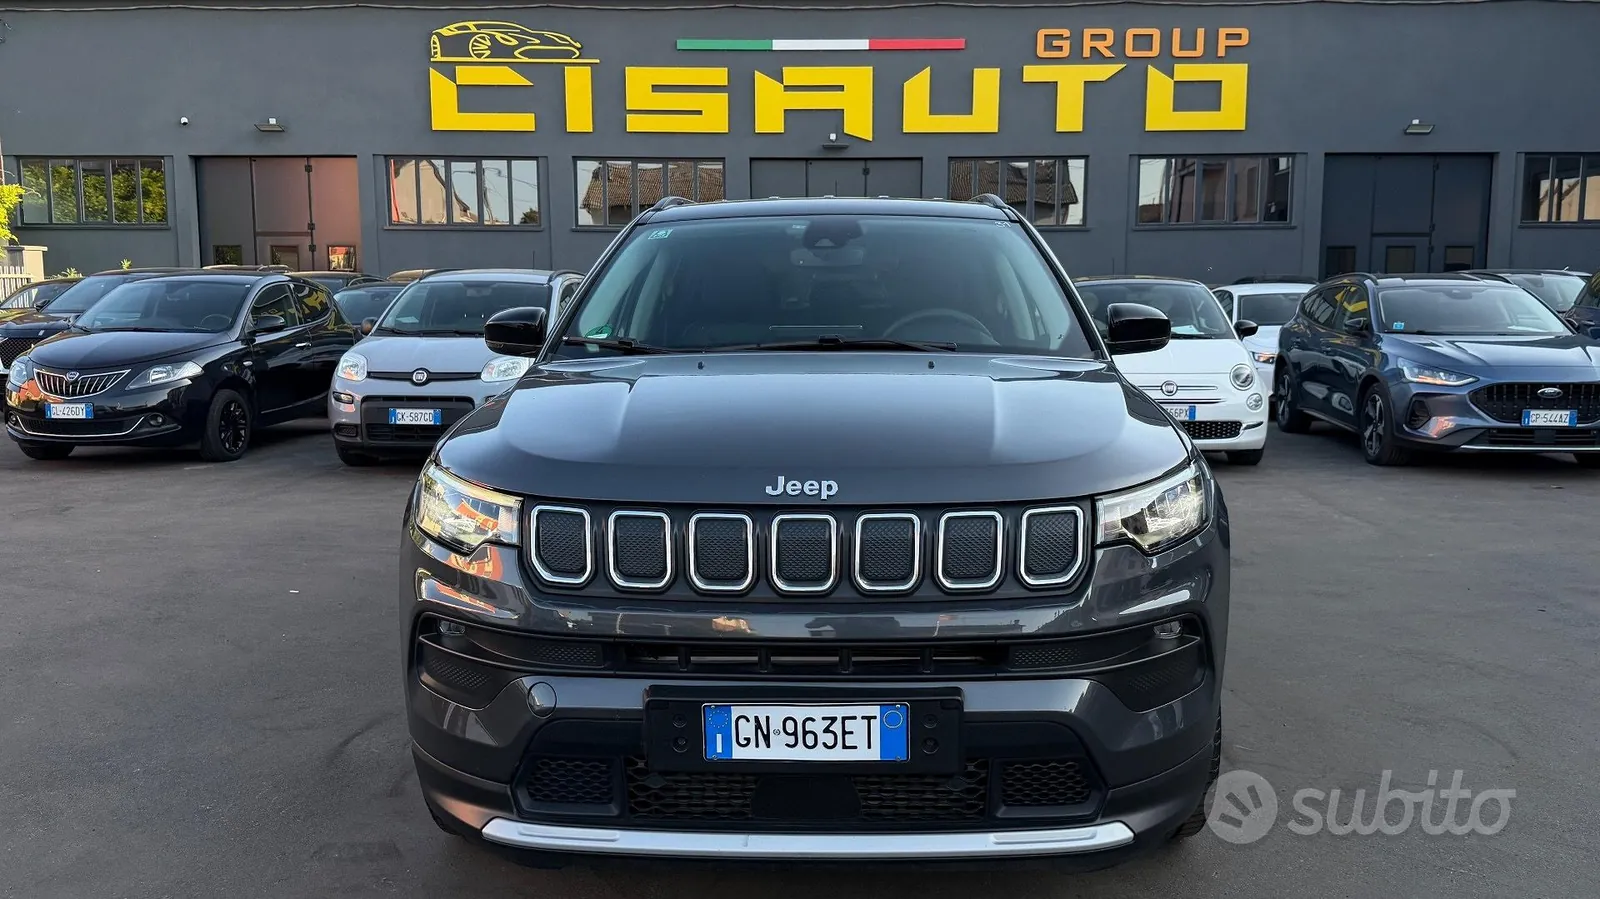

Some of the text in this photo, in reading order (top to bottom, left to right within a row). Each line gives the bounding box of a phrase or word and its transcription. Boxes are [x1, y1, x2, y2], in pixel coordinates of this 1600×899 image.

[1036, 27, 1249, 58] GROUP
[429, 63, 1249, 141] CISAUTO
[765, 475, 839, 500] Jeep
